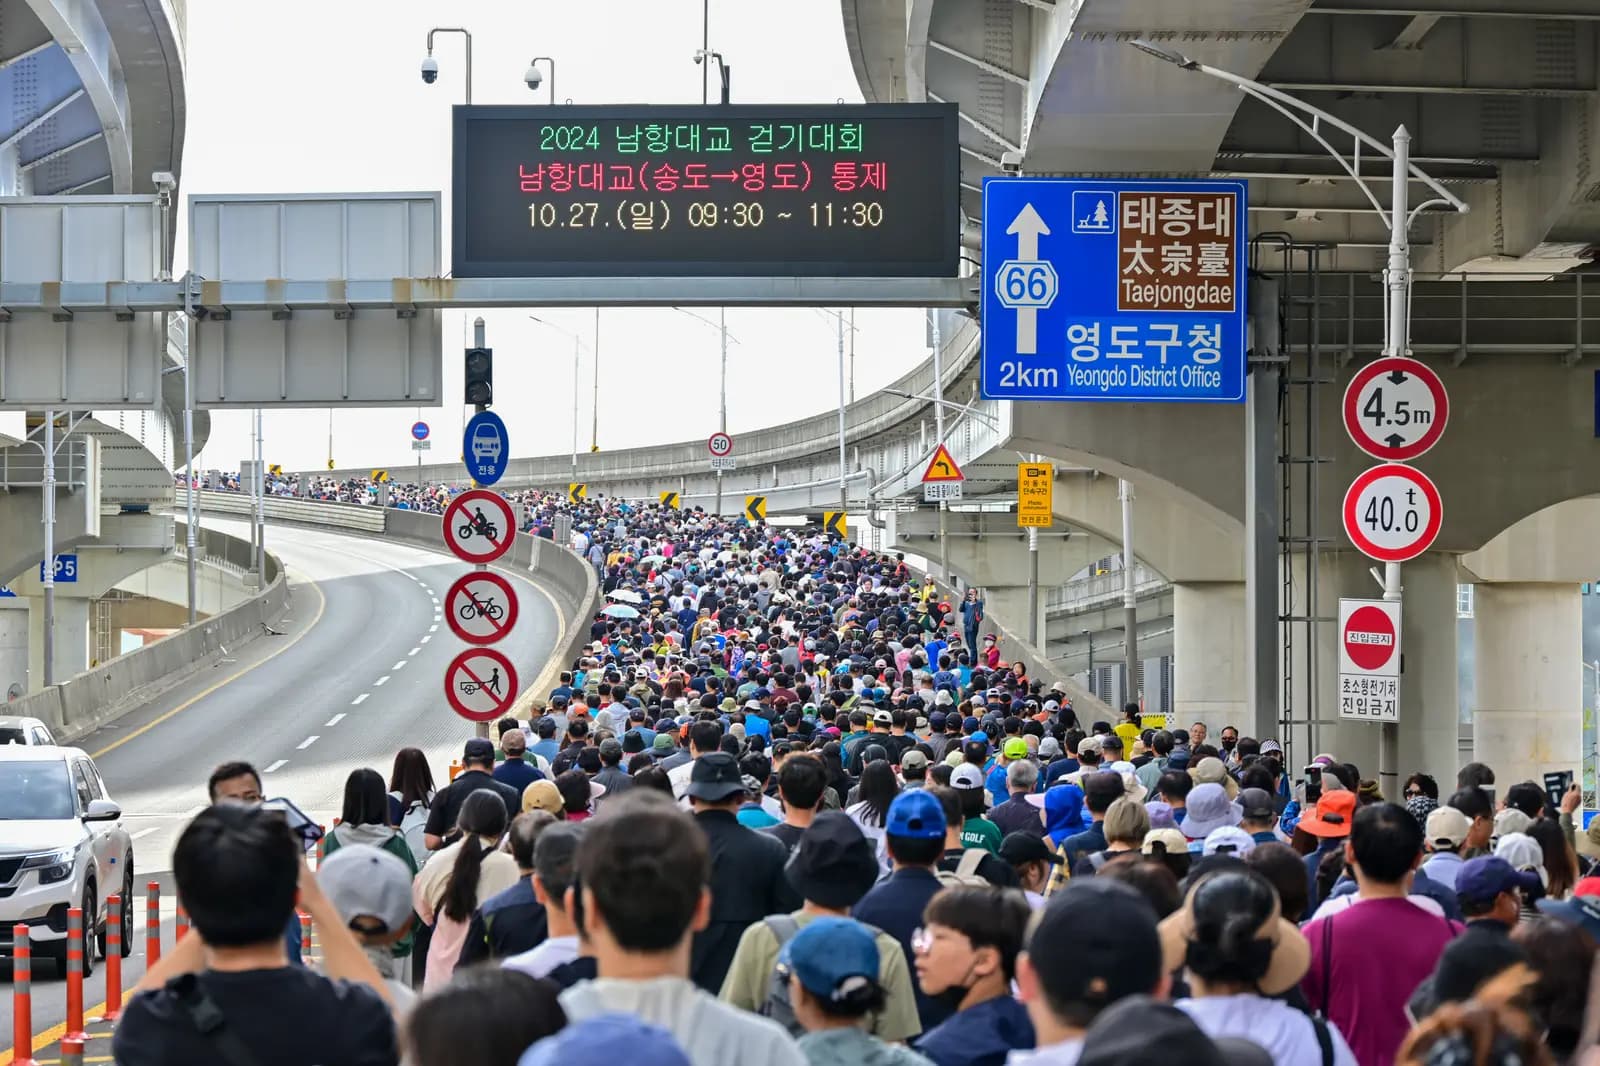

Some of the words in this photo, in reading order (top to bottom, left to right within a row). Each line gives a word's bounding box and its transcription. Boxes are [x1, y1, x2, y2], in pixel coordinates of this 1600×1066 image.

[540, 126, 600, 151] 2024
[616, 125, 733, 153] 남항대교
[748, 124, 862, 153] 걷기대회
[832, 162, 886, 192] 통제
[528, 201, 670, 230] 10.27.(일)
[688, 203, 764, 227] 09:30
[810, 203, 883, 227] 11:30
[1122, 197, 1231, 237] 태종대
[1122, 240, 1230, 277] 太宗臺
[1005, 267, 1048, 301] 66
[1122, 279, 1232, 309] Taejongdae
[1066, 322, 1222, 364] 영도구청
[1000, 362, 1058, 387] 2km
[1067, 364, 1127, 391] Yeongdo
[1131, 362, 1177, 387] District
[1180, 362, 1221, 388] Office
[713, 438, 727, 450] 50
[478, 465, 496, 475] 전용
[1350, 632, 1390, 645] 진입금지
[1343, 678, 1396, 698] 초소형전기차
[1342, 697, 1396, 717] 진입금지
[965, 832, 986, 843] GOLF
